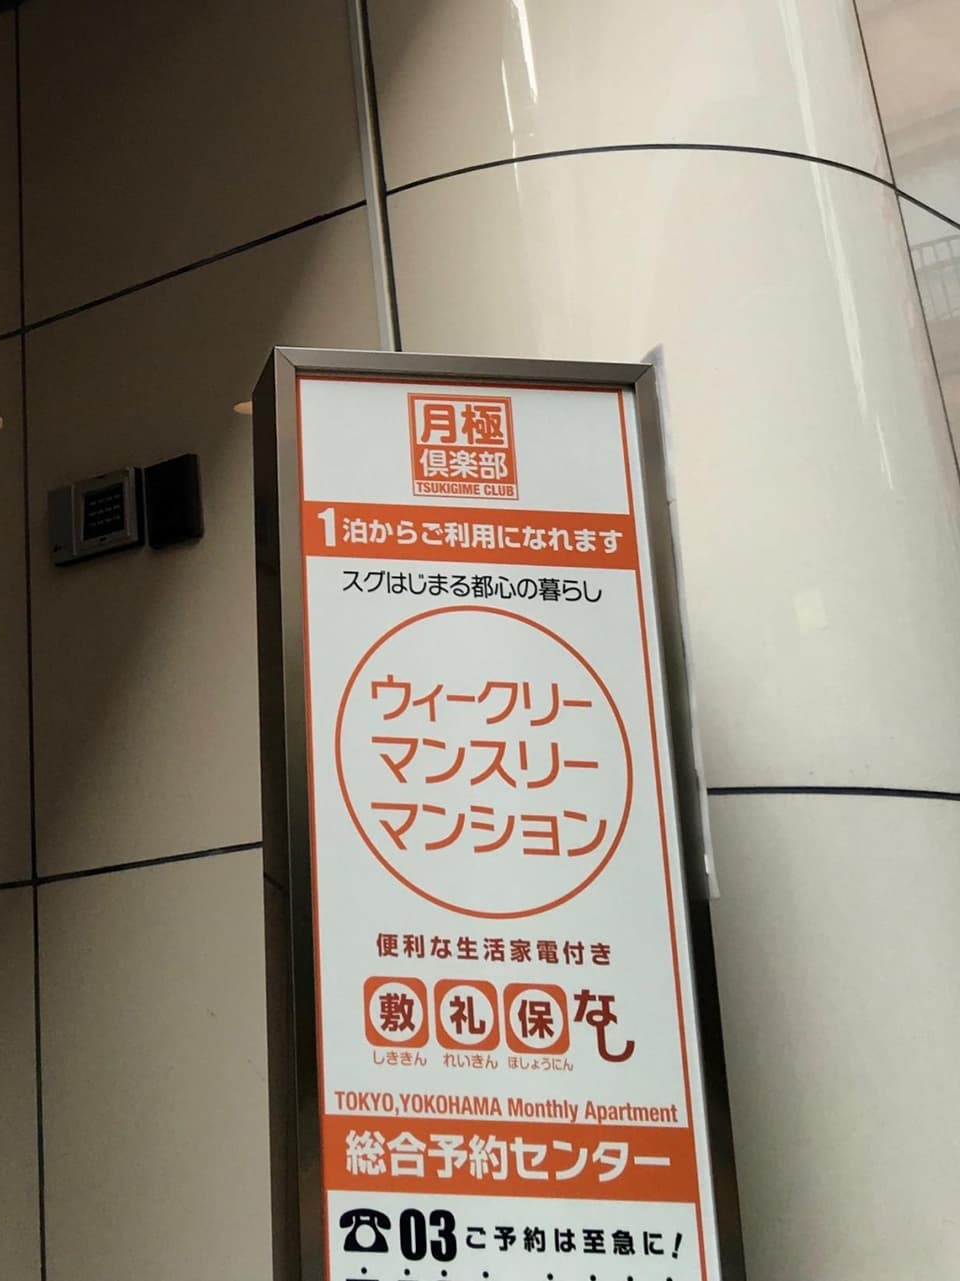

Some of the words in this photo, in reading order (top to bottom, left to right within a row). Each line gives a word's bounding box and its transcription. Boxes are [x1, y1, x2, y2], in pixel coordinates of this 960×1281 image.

[420, 403, 505, 445] 月極
[419, 447, 509, 481] 倶楽部
[415, 481, 481, 496] TSUKIGIME
[483, 484, 515, 497] CLUB
[317, 506, 623, 555] 1泊からご利用になれます
[341, 568, 603, 603] スグはじまる都心の暮らし
[370, 674, 593, 727] ウィークリー
[370, 736, 600, 790] マンスリー
[370, 801, 607, 858] マンション
[375, 932, 612, 966] 便利な生活家電付き
[372, 1050, 428, 1068] しききん
[442, 1052, 499, 1070] れいきん
[507, 1055, 574, 1072] ほしょうにん
[334, 1090, 503, 1117] TOKYO,YOKOHAMA
[507, 1098, 579, 1123] Monthly
[584, 1101, 678, 1125] Apartment
[344, 1129, 671, 1183] 総合予約センター
[399, 1208, 458, 1262] 03
